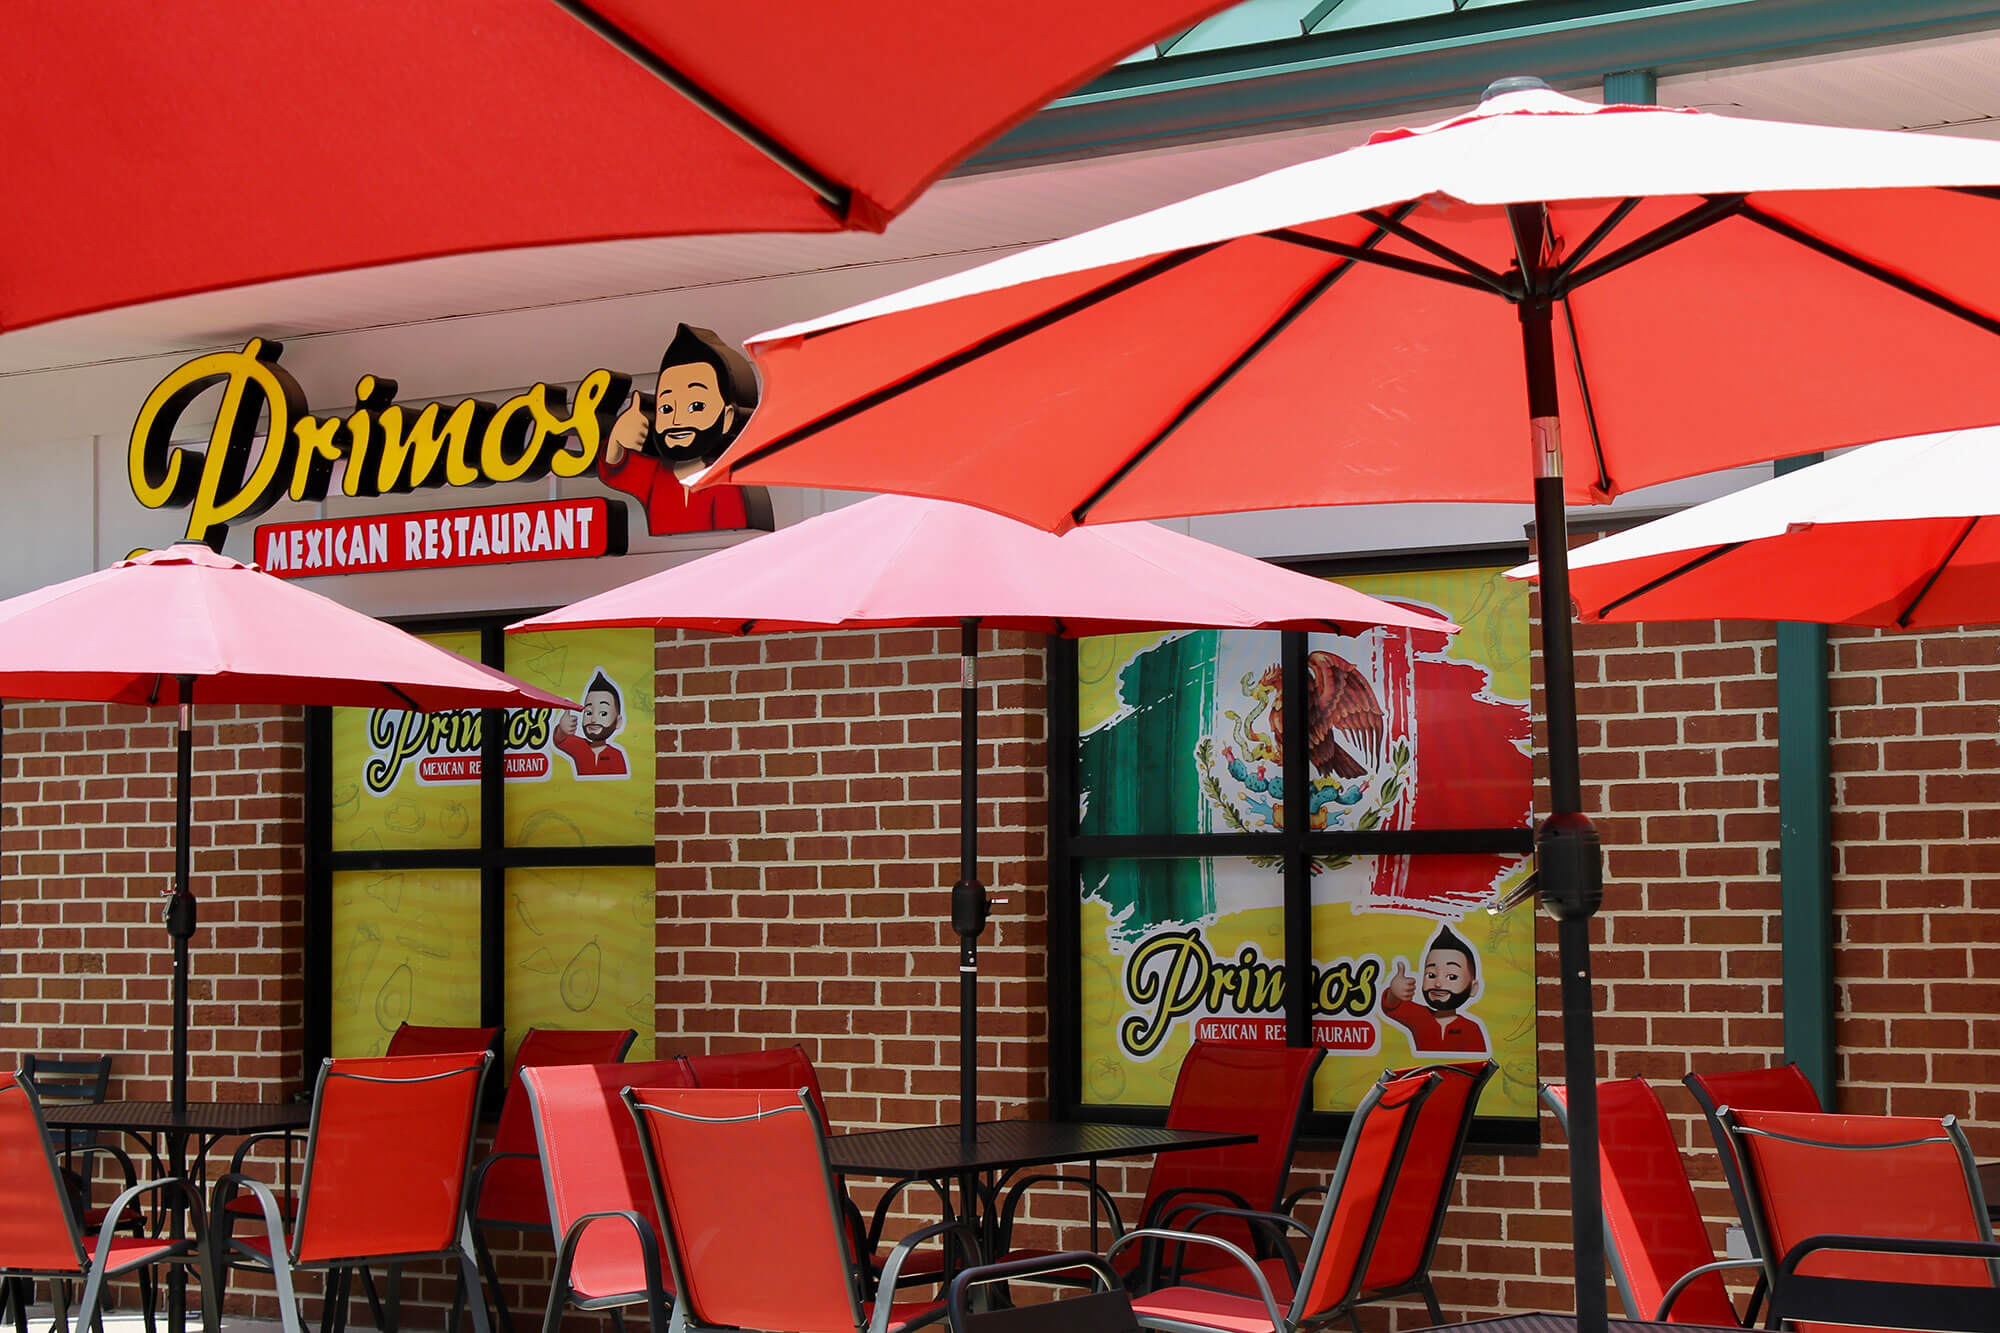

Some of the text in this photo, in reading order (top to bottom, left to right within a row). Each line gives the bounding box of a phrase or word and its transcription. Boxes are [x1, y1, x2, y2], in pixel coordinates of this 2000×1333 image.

[128, 336, 612, 552] Primos
[265, 507, 593, 571] MEXICAN RESTAURANT
[423, 757, 545, 776] MEXICAN REAURANT
[1200, 1023, 1257, 1040] MEXICAN
